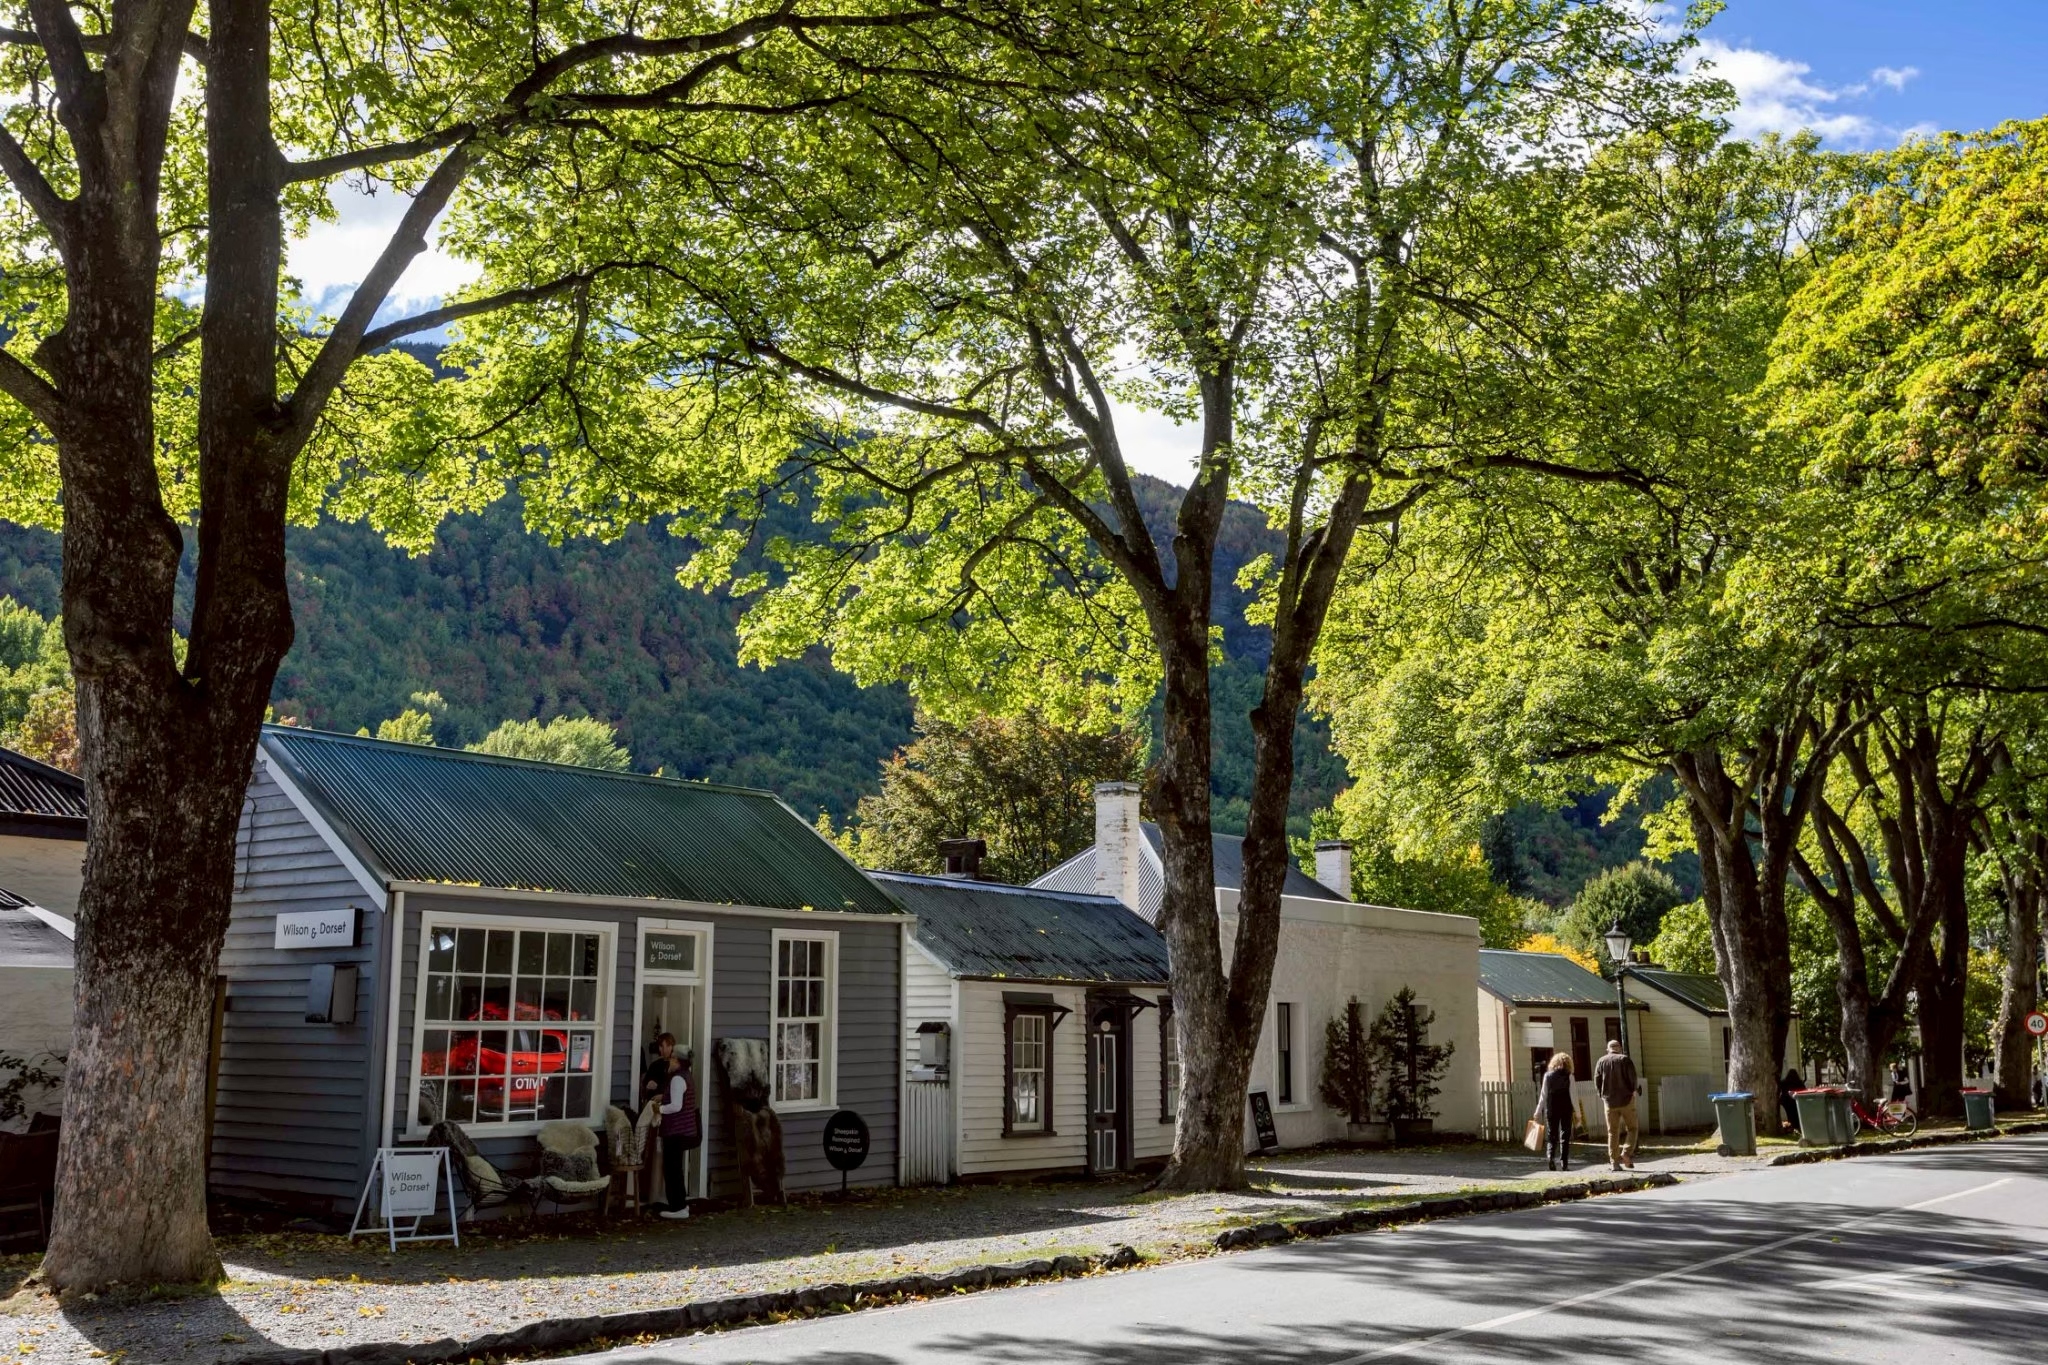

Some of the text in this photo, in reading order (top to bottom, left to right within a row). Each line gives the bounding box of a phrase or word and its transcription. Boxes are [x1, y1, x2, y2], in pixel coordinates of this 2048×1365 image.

[283, 921, 347, 939] Wilson & Dorset
[650, 940, 676, 951] Wilson
[650, 951, 682, 963] & Dorset
[2030, 1019, 2044, 1029] 40
[391, 1171, 422, 1181] Wilson
[390, 1181, 430, 1195] & Dorset
